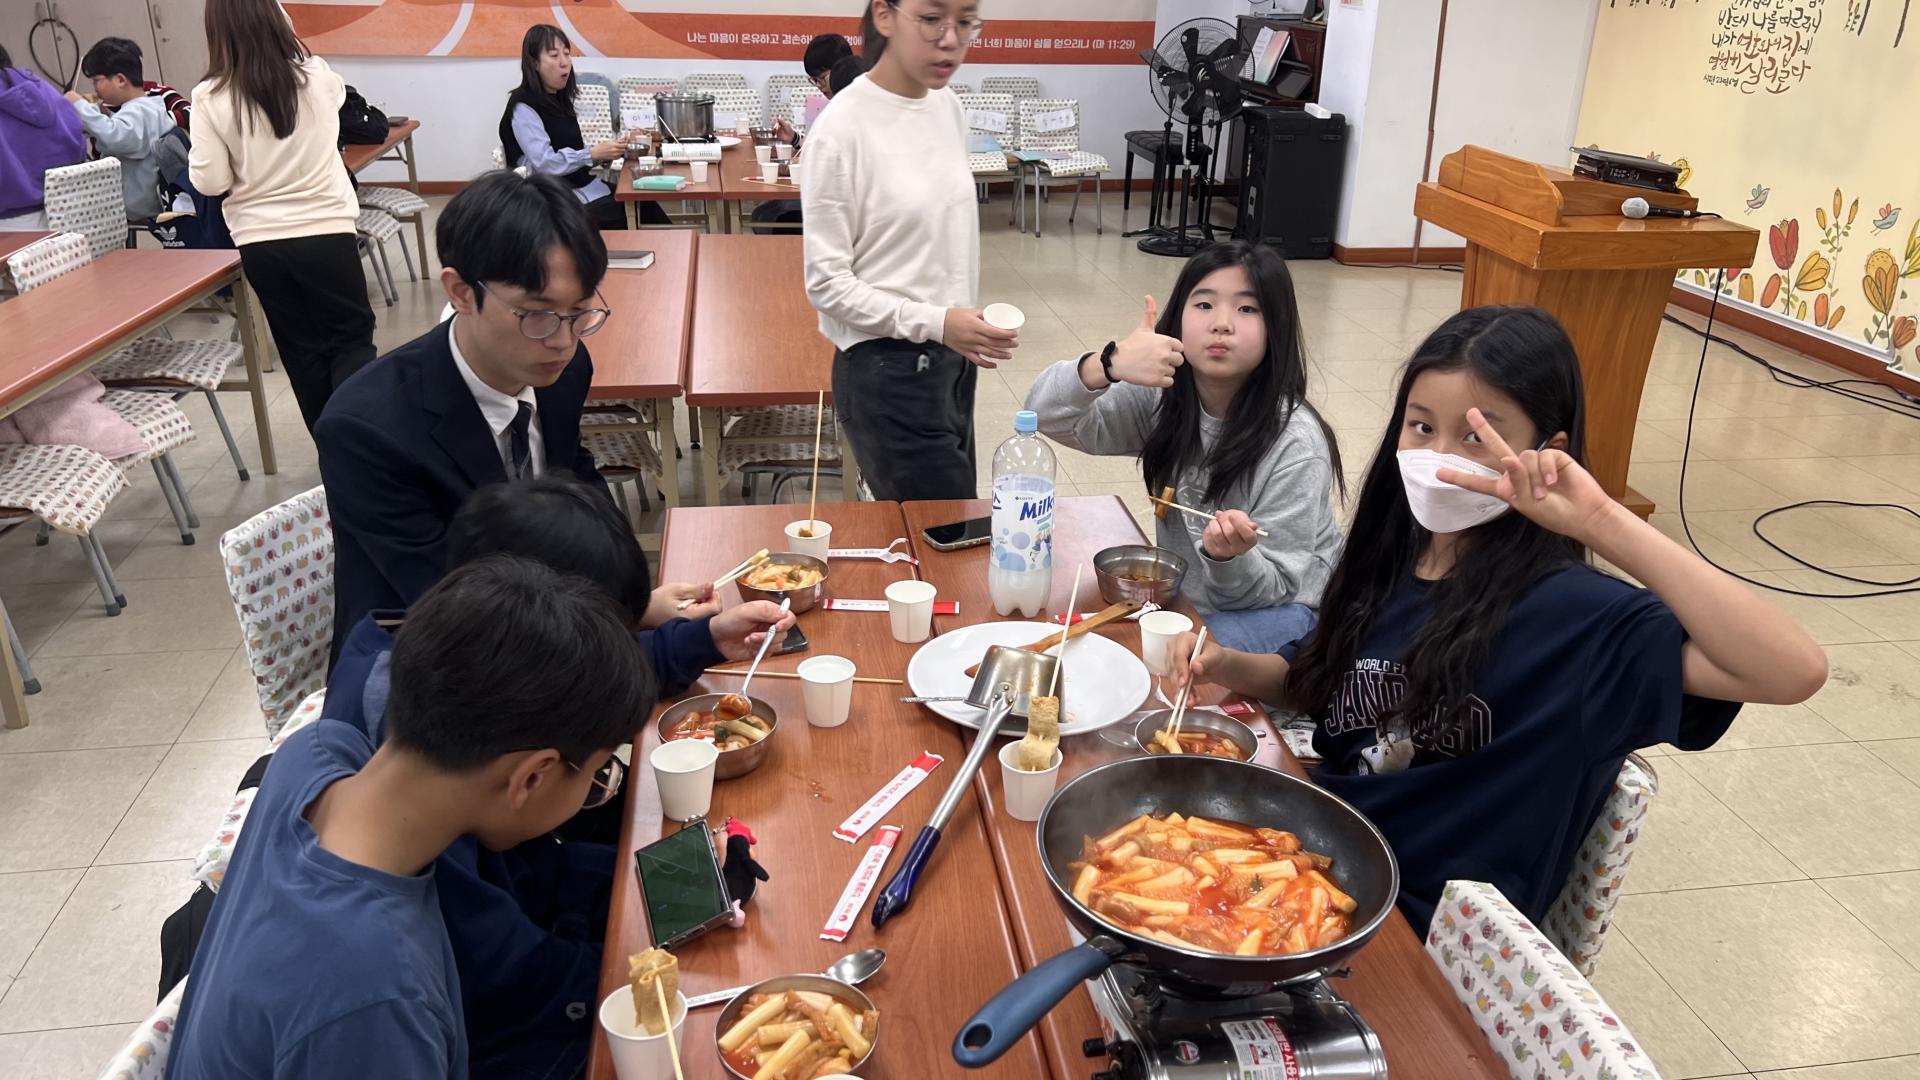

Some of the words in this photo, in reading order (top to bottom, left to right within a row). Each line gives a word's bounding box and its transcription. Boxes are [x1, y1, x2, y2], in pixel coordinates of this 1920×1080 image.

[687, 32, 707, 43] 나는
[709, 32, 738, 43] 마음이
[741, 33, 779, 44] 온유하고
[782, 34, 812, 45] 겸손하
[984, 38, 1002, 48] 너희
[1005, 38, 1031, 48] 마음이
[1054, 38, 1089, 49] 얻으리니
[1107, 39, 1136, 50] 11:29)
[1711, 31, 1737, 48] 내가
[1355, 658, 1391, 673] WORLD
[1284, 1053, 1299, 1080] 사용
